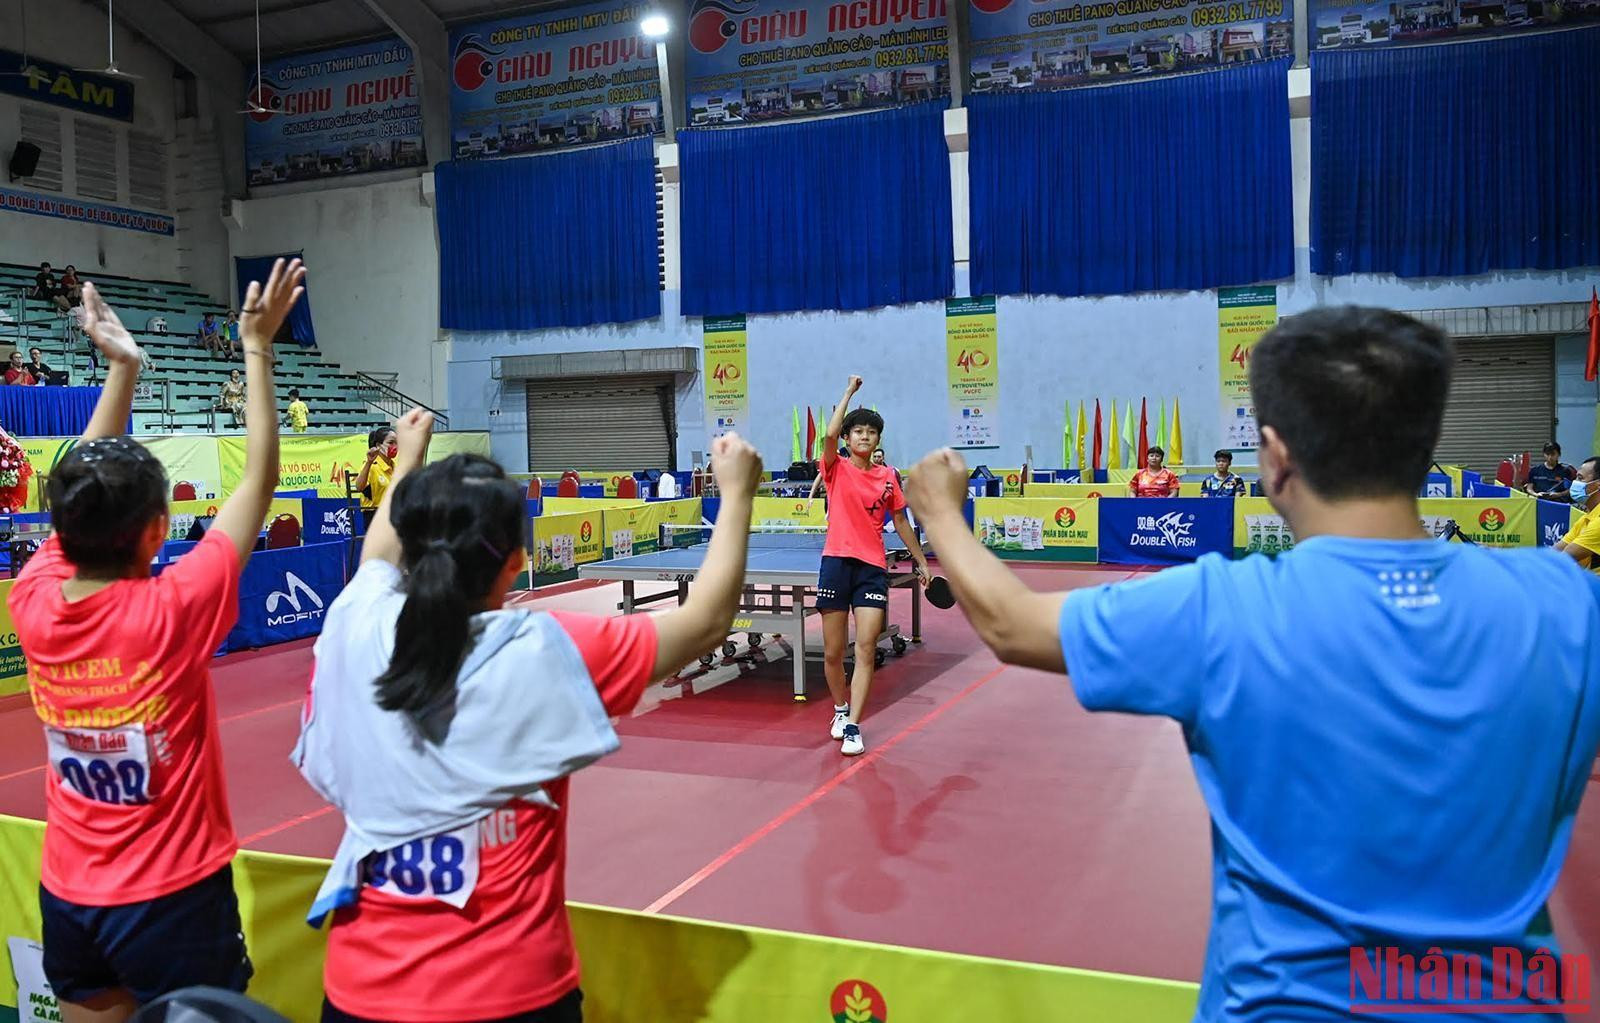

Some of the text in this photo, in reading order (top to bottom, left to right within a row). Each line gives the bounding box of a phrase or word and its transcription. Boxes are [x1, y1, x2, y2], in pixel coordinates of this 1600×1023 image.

[739, 9, 807, 45] GIÀU
[1028, 11, 1053, 28] CHO
[1054, 3, 1082, 24] THUÊ
[1083, 2, 1114, 21] PANO
[1191, 0, 1283, 28] 0932.81.7799
[490, 27, 523, 45] CÔNG
[525, 24, 541, 40] TY
[545, 19, 579, 35] TNHH
[582, 13, 609, 29] MTV
[739, 52, 760, 67] CHO
[760, 47, 784, 64] THUÊ
[784, 45, 811, 61] PANO
[812, 36, 849, 57] QUẢNG
[278, 65, 307, 82] CÔNG
[309, 62, 322, 76] TY
[325, 57, 354, 74] TNHH
[357, 53, 381, 69] MTV
[496, 50, 552, 85] GIÀU
[346, 64, 416, 107] NGUYỄ
[607, 82, 661, 105] 0932.81.77
[957, 349, 990, 374] 40
[1230, 343, 1249, 370] 4
[713, 363, 741, 386] 40
[309, 475, 322, 484] GIA
[1130, 533, 1196, 547] DOUBLE FISH
[267, 609, 324, 627] MOFIT
[731, 618, 752, 628] ISH
[49, 657, 122, 681] VICEM
[60, 757, 149, 806] 089
